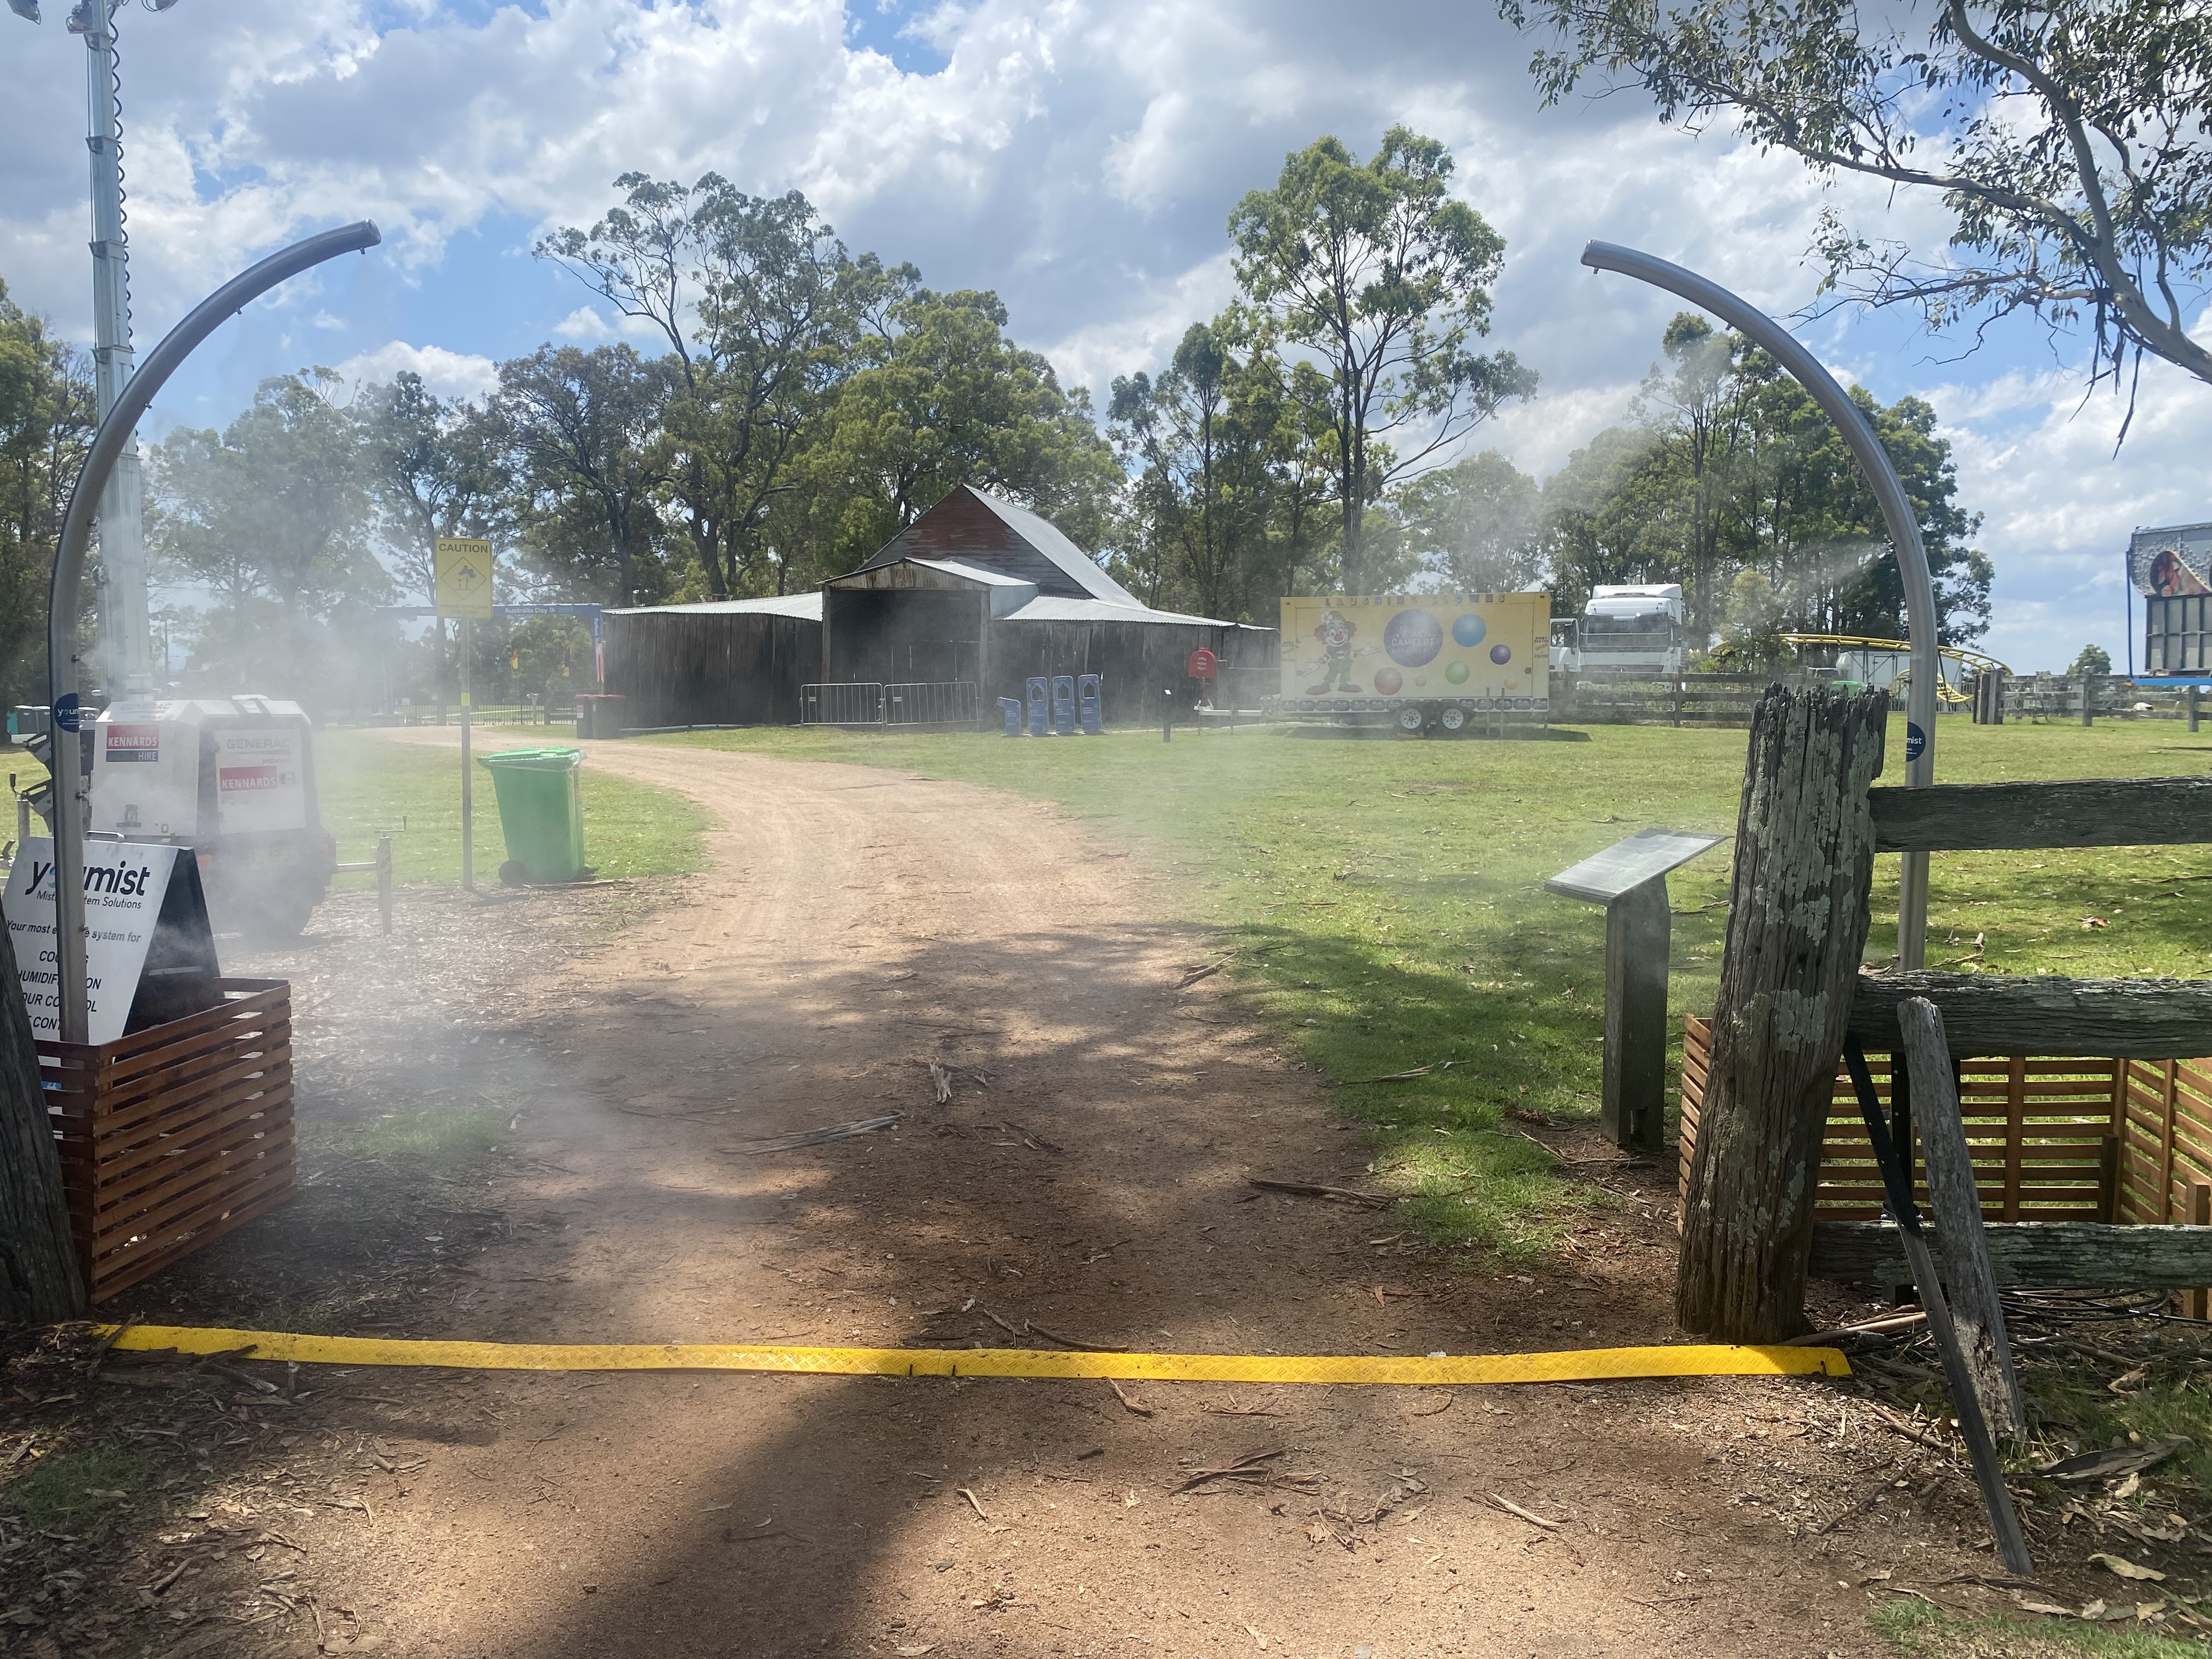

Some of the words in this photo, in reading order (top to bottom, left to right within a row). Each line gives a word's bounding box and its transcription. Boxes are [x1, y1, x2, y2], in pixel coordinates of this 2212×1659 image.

[439, 543, 488, 553] CAUTION
[1391, 638, 1435, 646] CAMELOT
[108, 736, 157, 747] KENNARDS
[227, 738, 290, 749] GENERAC
[138, 752, 156, 760] HIRE
[222, 777, 275, 789] KENNARDS
[37, 890, 55, 901] Mist
[102, 897, 142, 909] Solutions
[7, 919, 27, 931] Your
[28, 924, 50, 934] most
[92, 930, 125, 941] system
[127, 932, 141, 943] for
